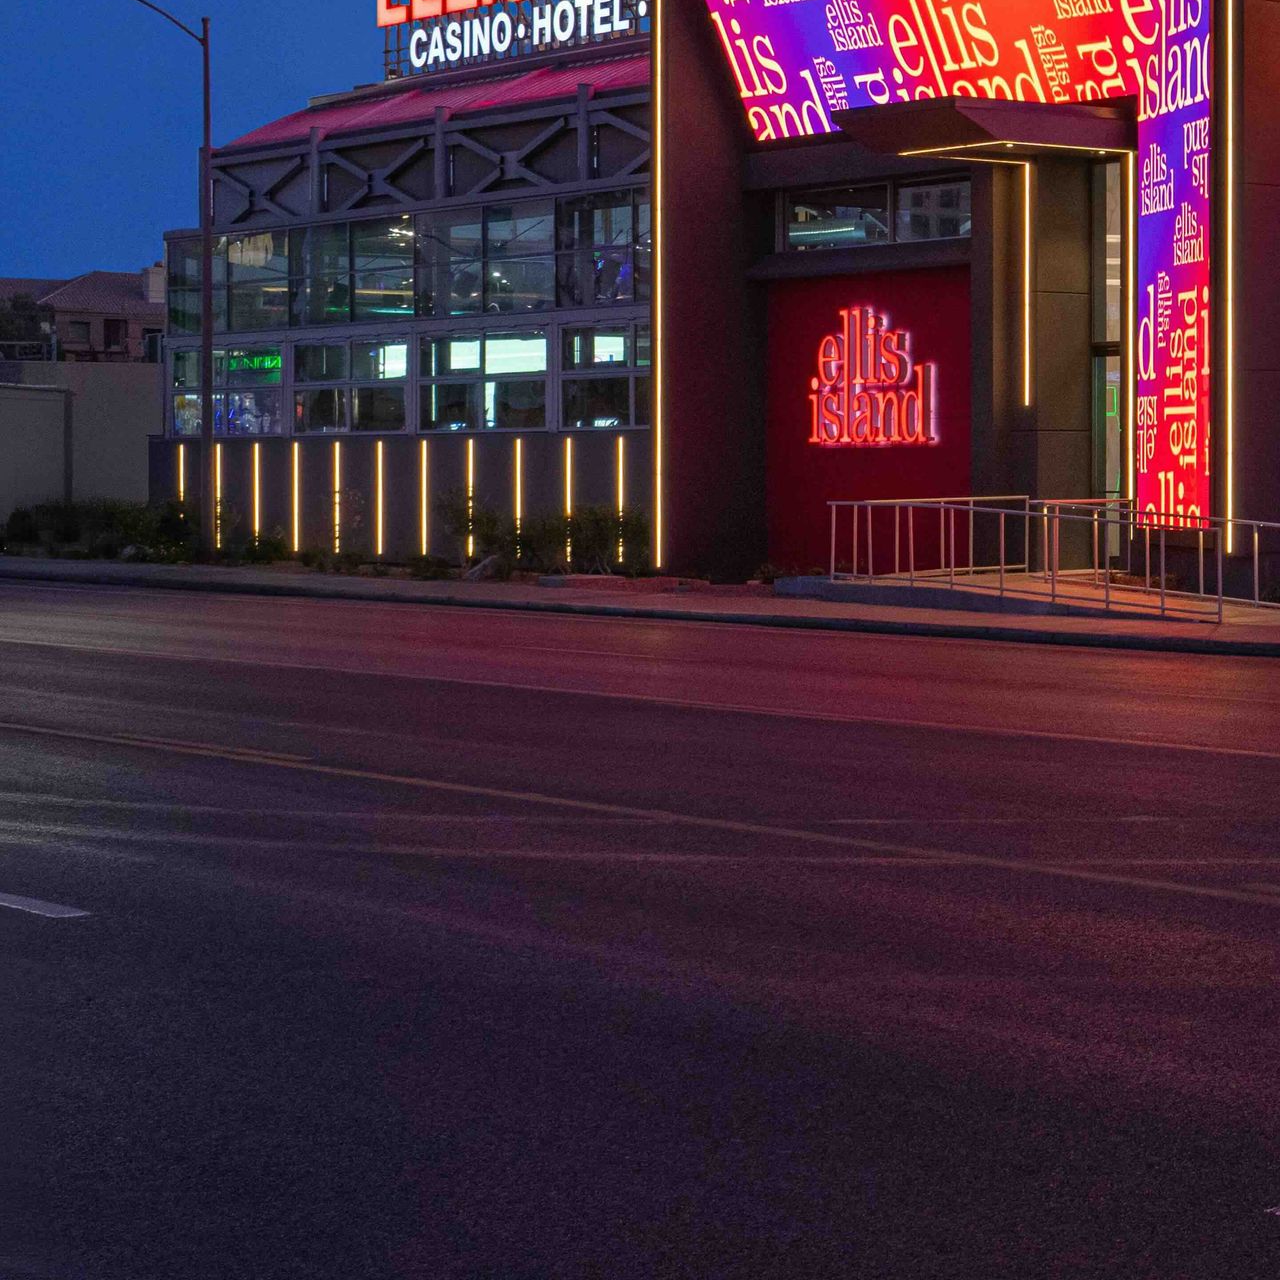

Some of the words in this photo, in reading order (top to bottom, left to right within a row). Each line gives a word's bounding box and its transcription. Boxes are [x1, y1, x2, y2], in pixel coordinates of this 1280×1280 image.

[409, 12, 512, 68] CASINO
[827, 13, 883, 52] island
[1045, 28, 1070, 86] ellis
[1122, 32, 1210, 122] islan
[1141, 169, 1174, 216] island
[1143, 143, 1167, 185] ellis
[1173, 226, 1204, 266] island
[1175, 202, 1197, 237] ellis
[818, 307, 906, 385] ellis
[808, 364, 930, 444] island
[1164, 328, 1184, 455] ellis
[1178, 284, 1198, 470] island
